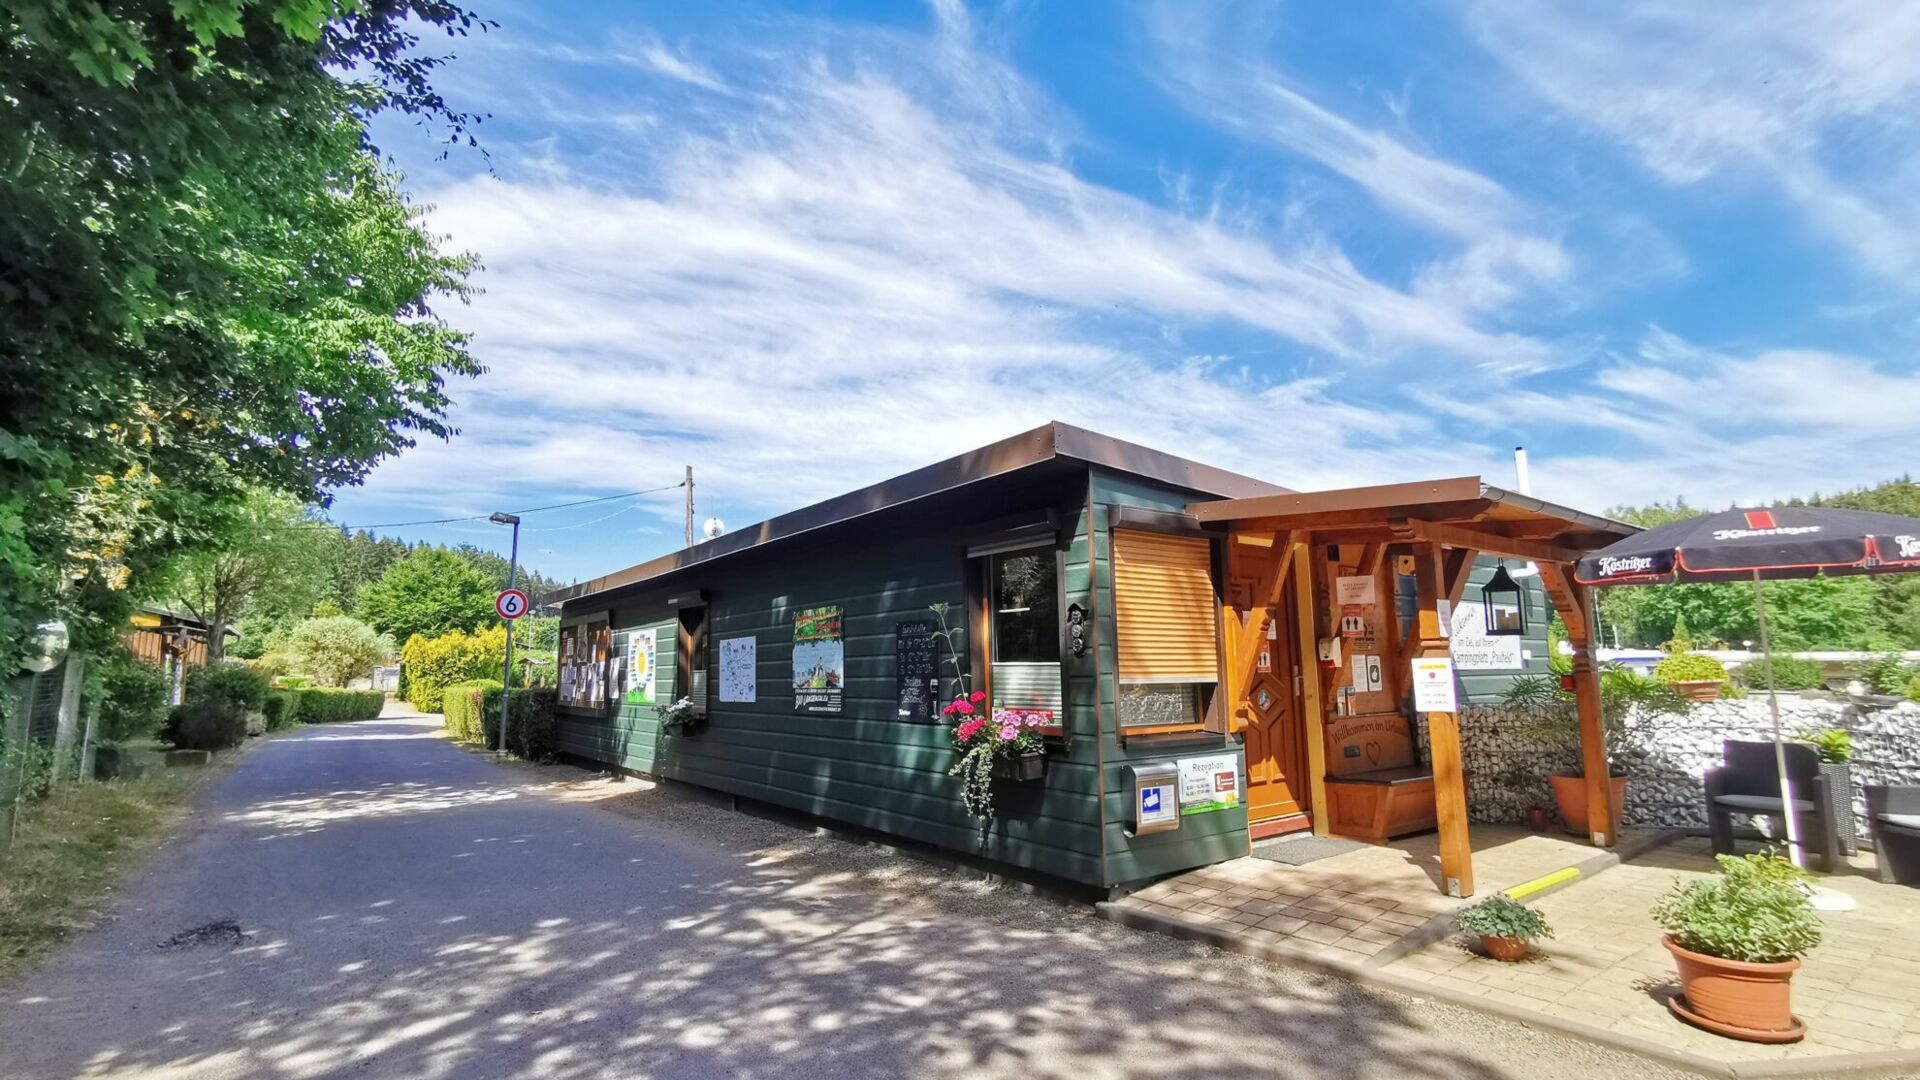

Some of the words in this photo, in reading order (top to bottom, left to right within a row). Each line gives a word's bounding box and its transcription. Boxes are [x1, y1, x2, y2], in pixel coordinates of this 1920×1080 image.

[1599, 556, 1652, 577] Köstritzer
[506, 595, 517, 612] 6
[1331, 721, 1374, 745] Willkommen
[1192, 762, 1224, 773] Rezeption
